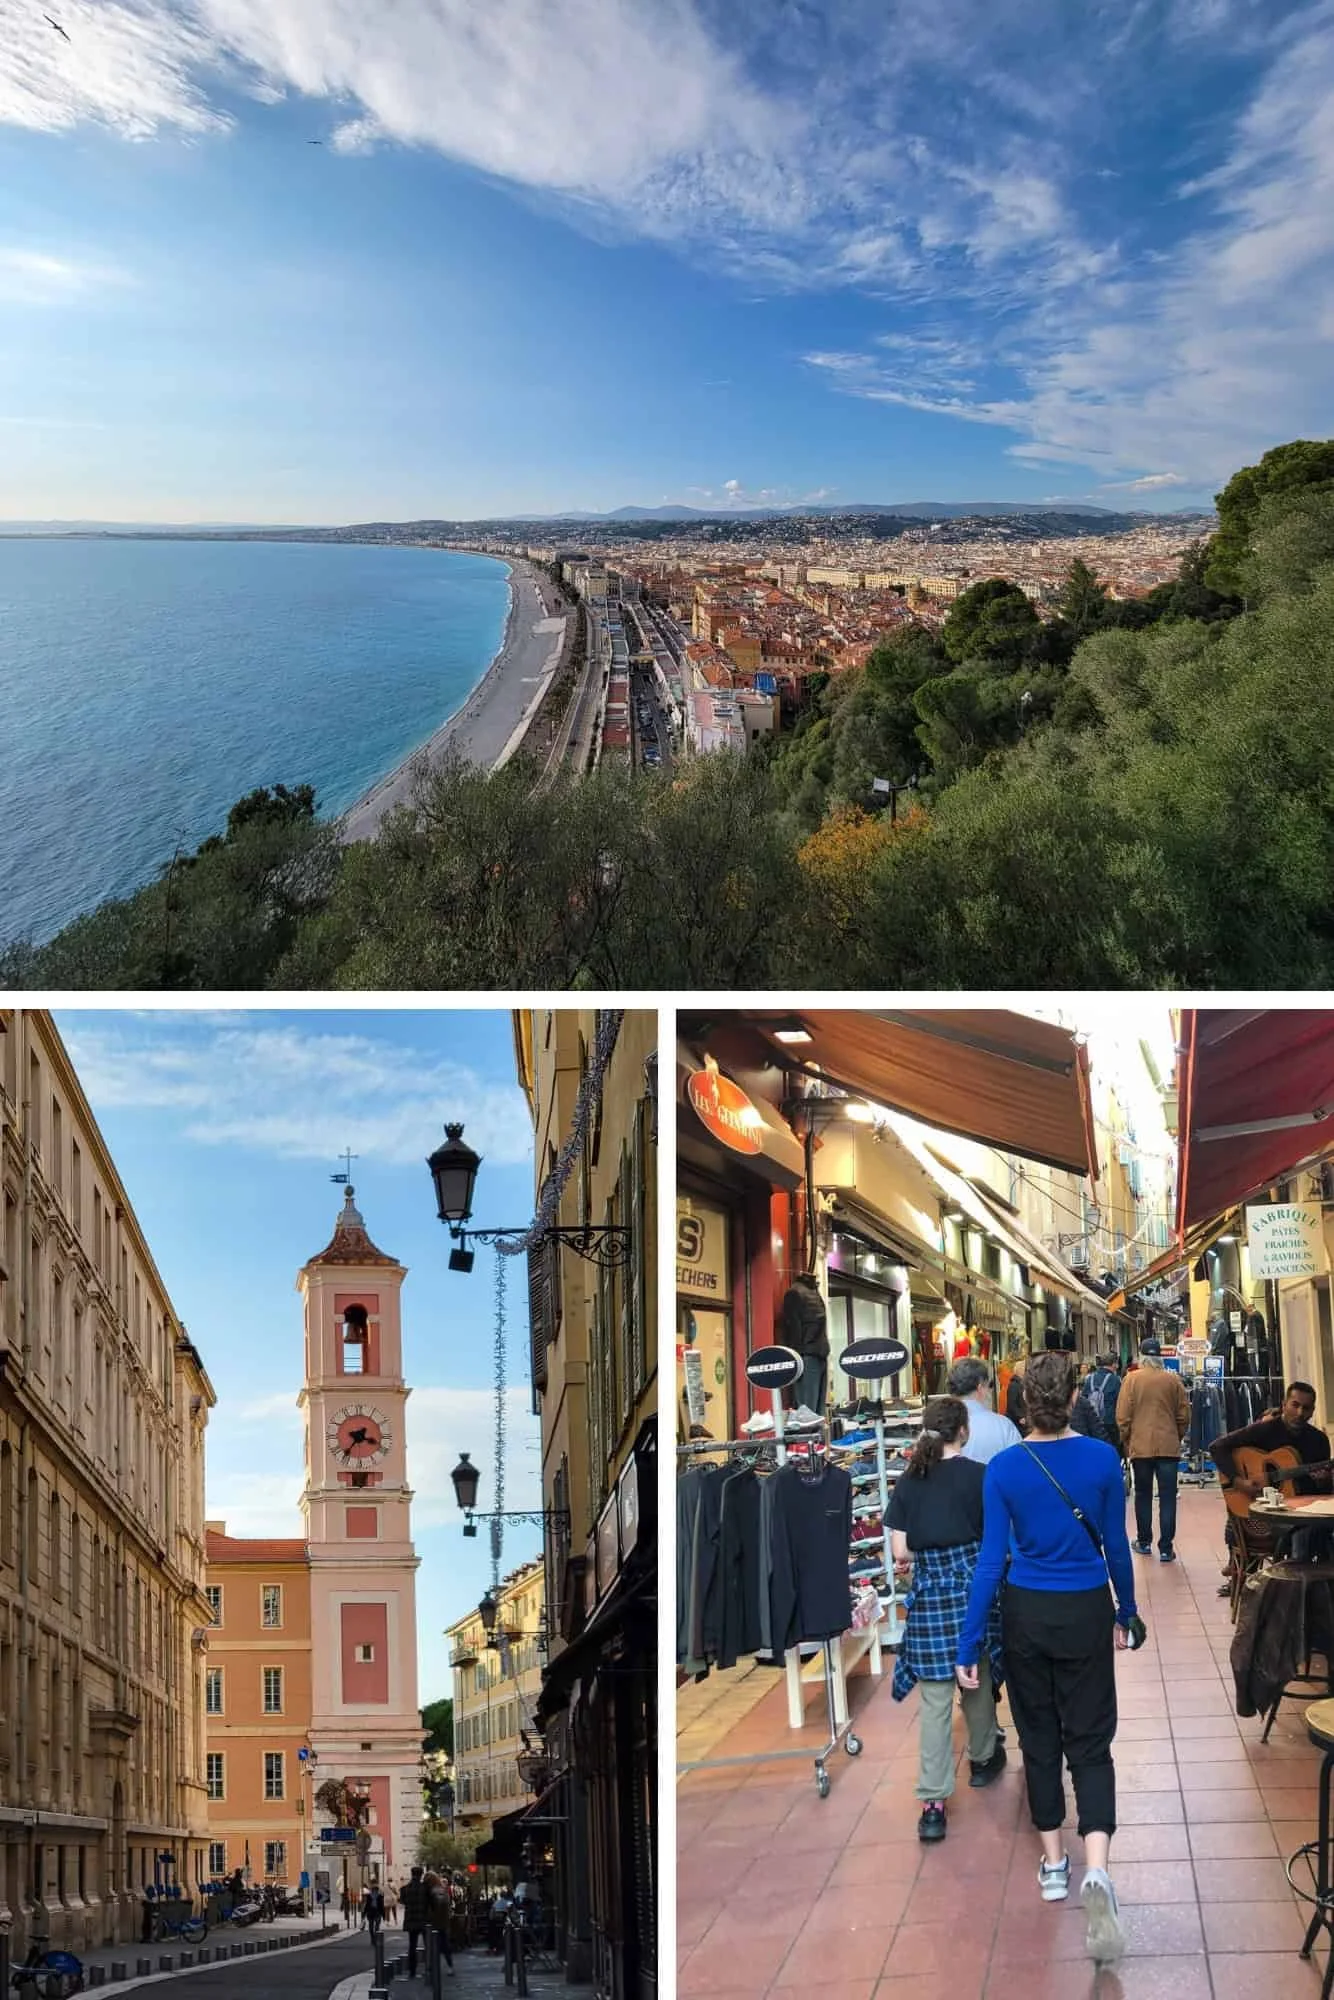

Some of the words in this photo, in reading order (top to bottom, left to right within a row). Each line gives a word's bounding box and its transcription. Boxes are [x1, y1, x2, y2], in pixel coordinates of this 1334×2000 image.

[1252, 1209, 1319, 1232] FABRIQUE
[840, 1351, 905, 1365] SKECHERS
[747, 1361, 795, 1374] SKECHERS
